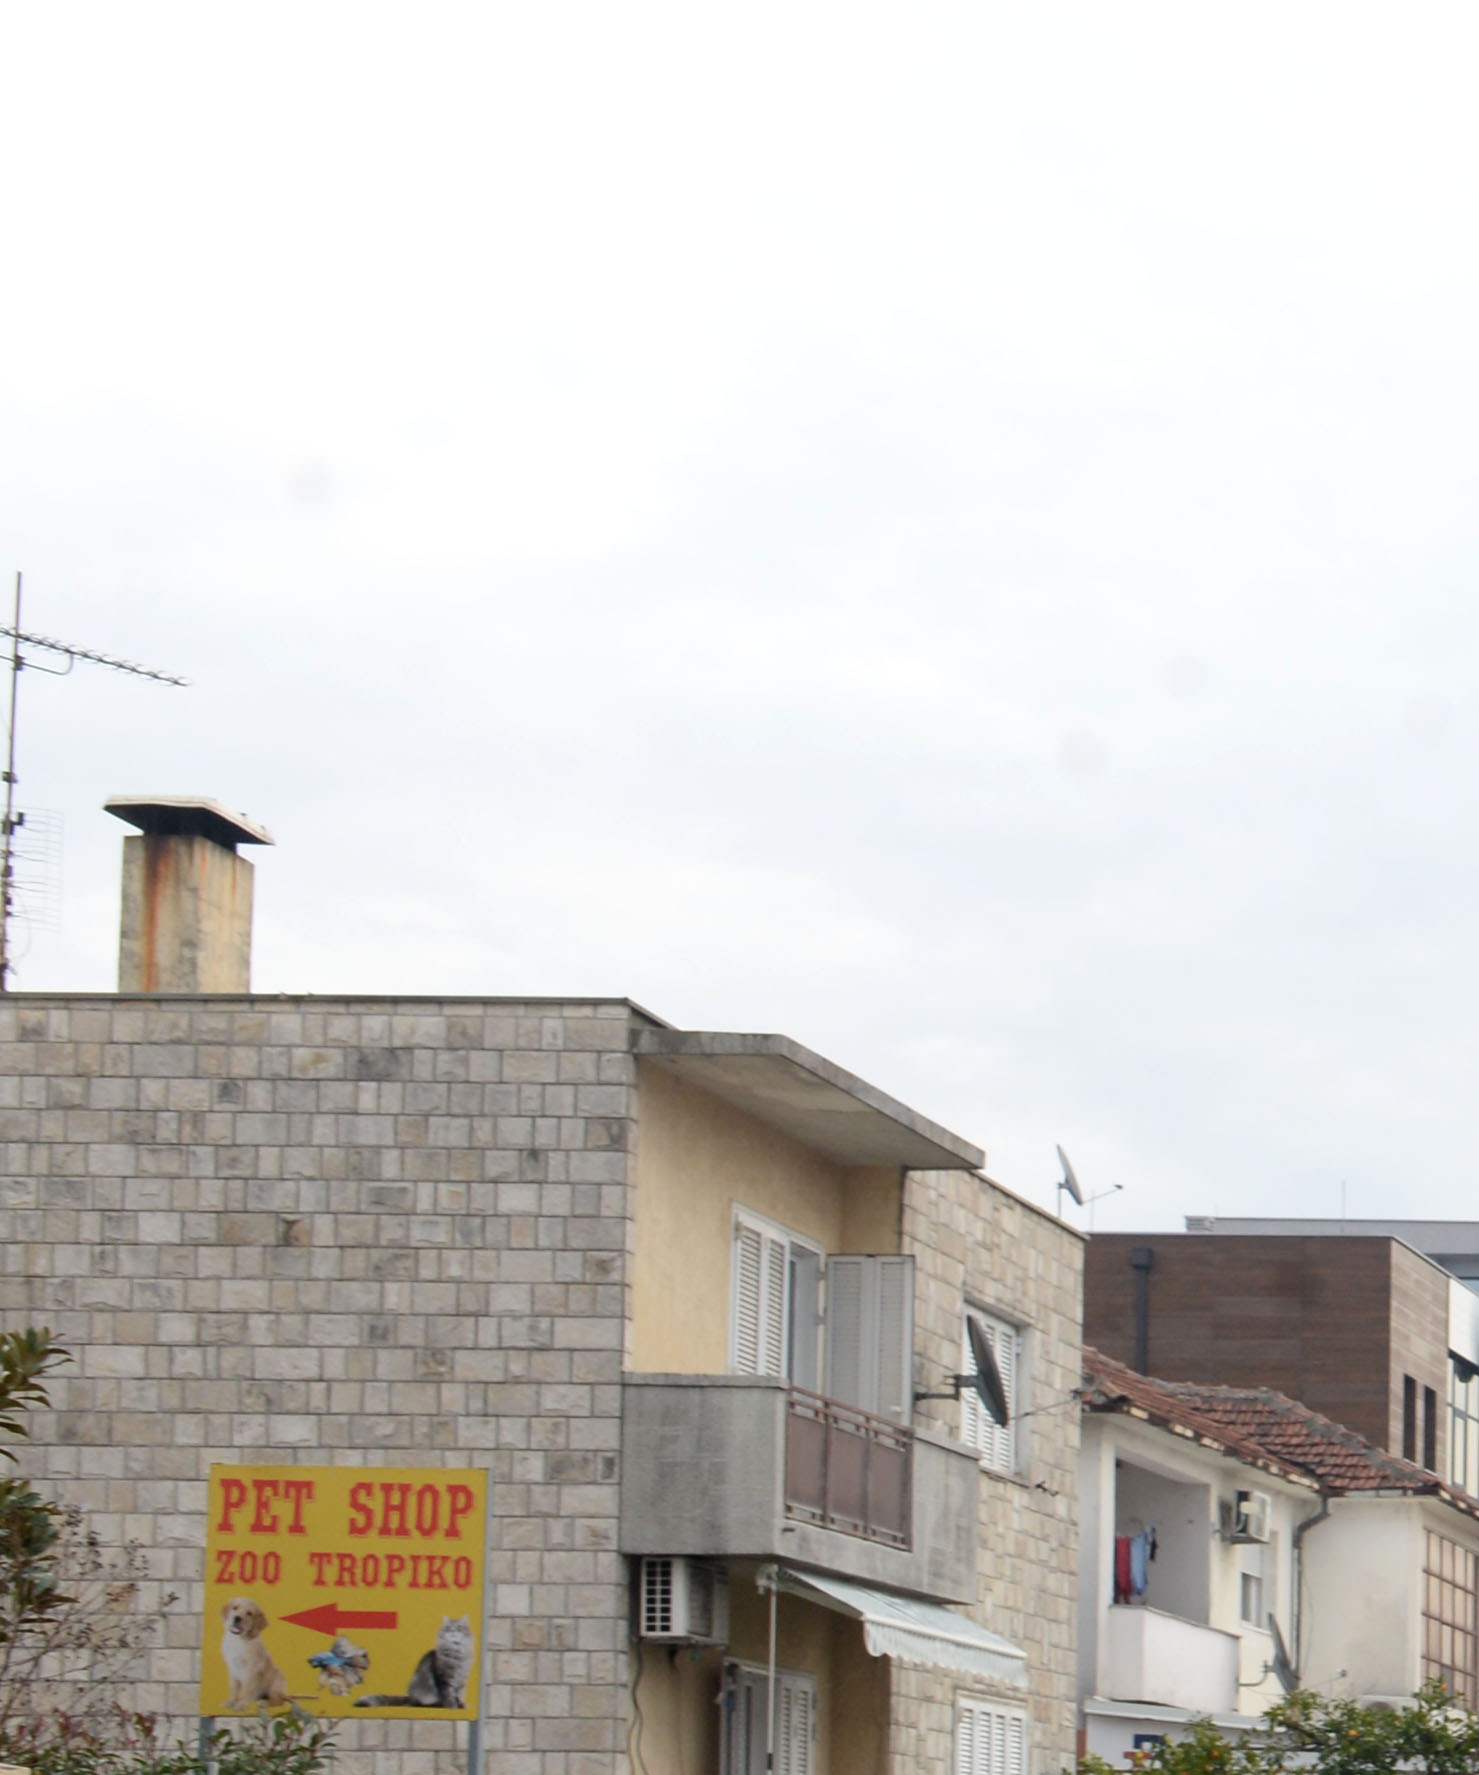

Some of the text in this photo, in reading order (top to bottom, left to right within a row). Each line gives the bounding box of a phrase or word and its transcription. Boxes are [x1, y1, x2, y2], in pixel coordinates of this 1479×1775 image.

[217, 1478, 475, 1538] PET SHOP
[214, 1550, 474, 1590] ZOO TROPIKO
